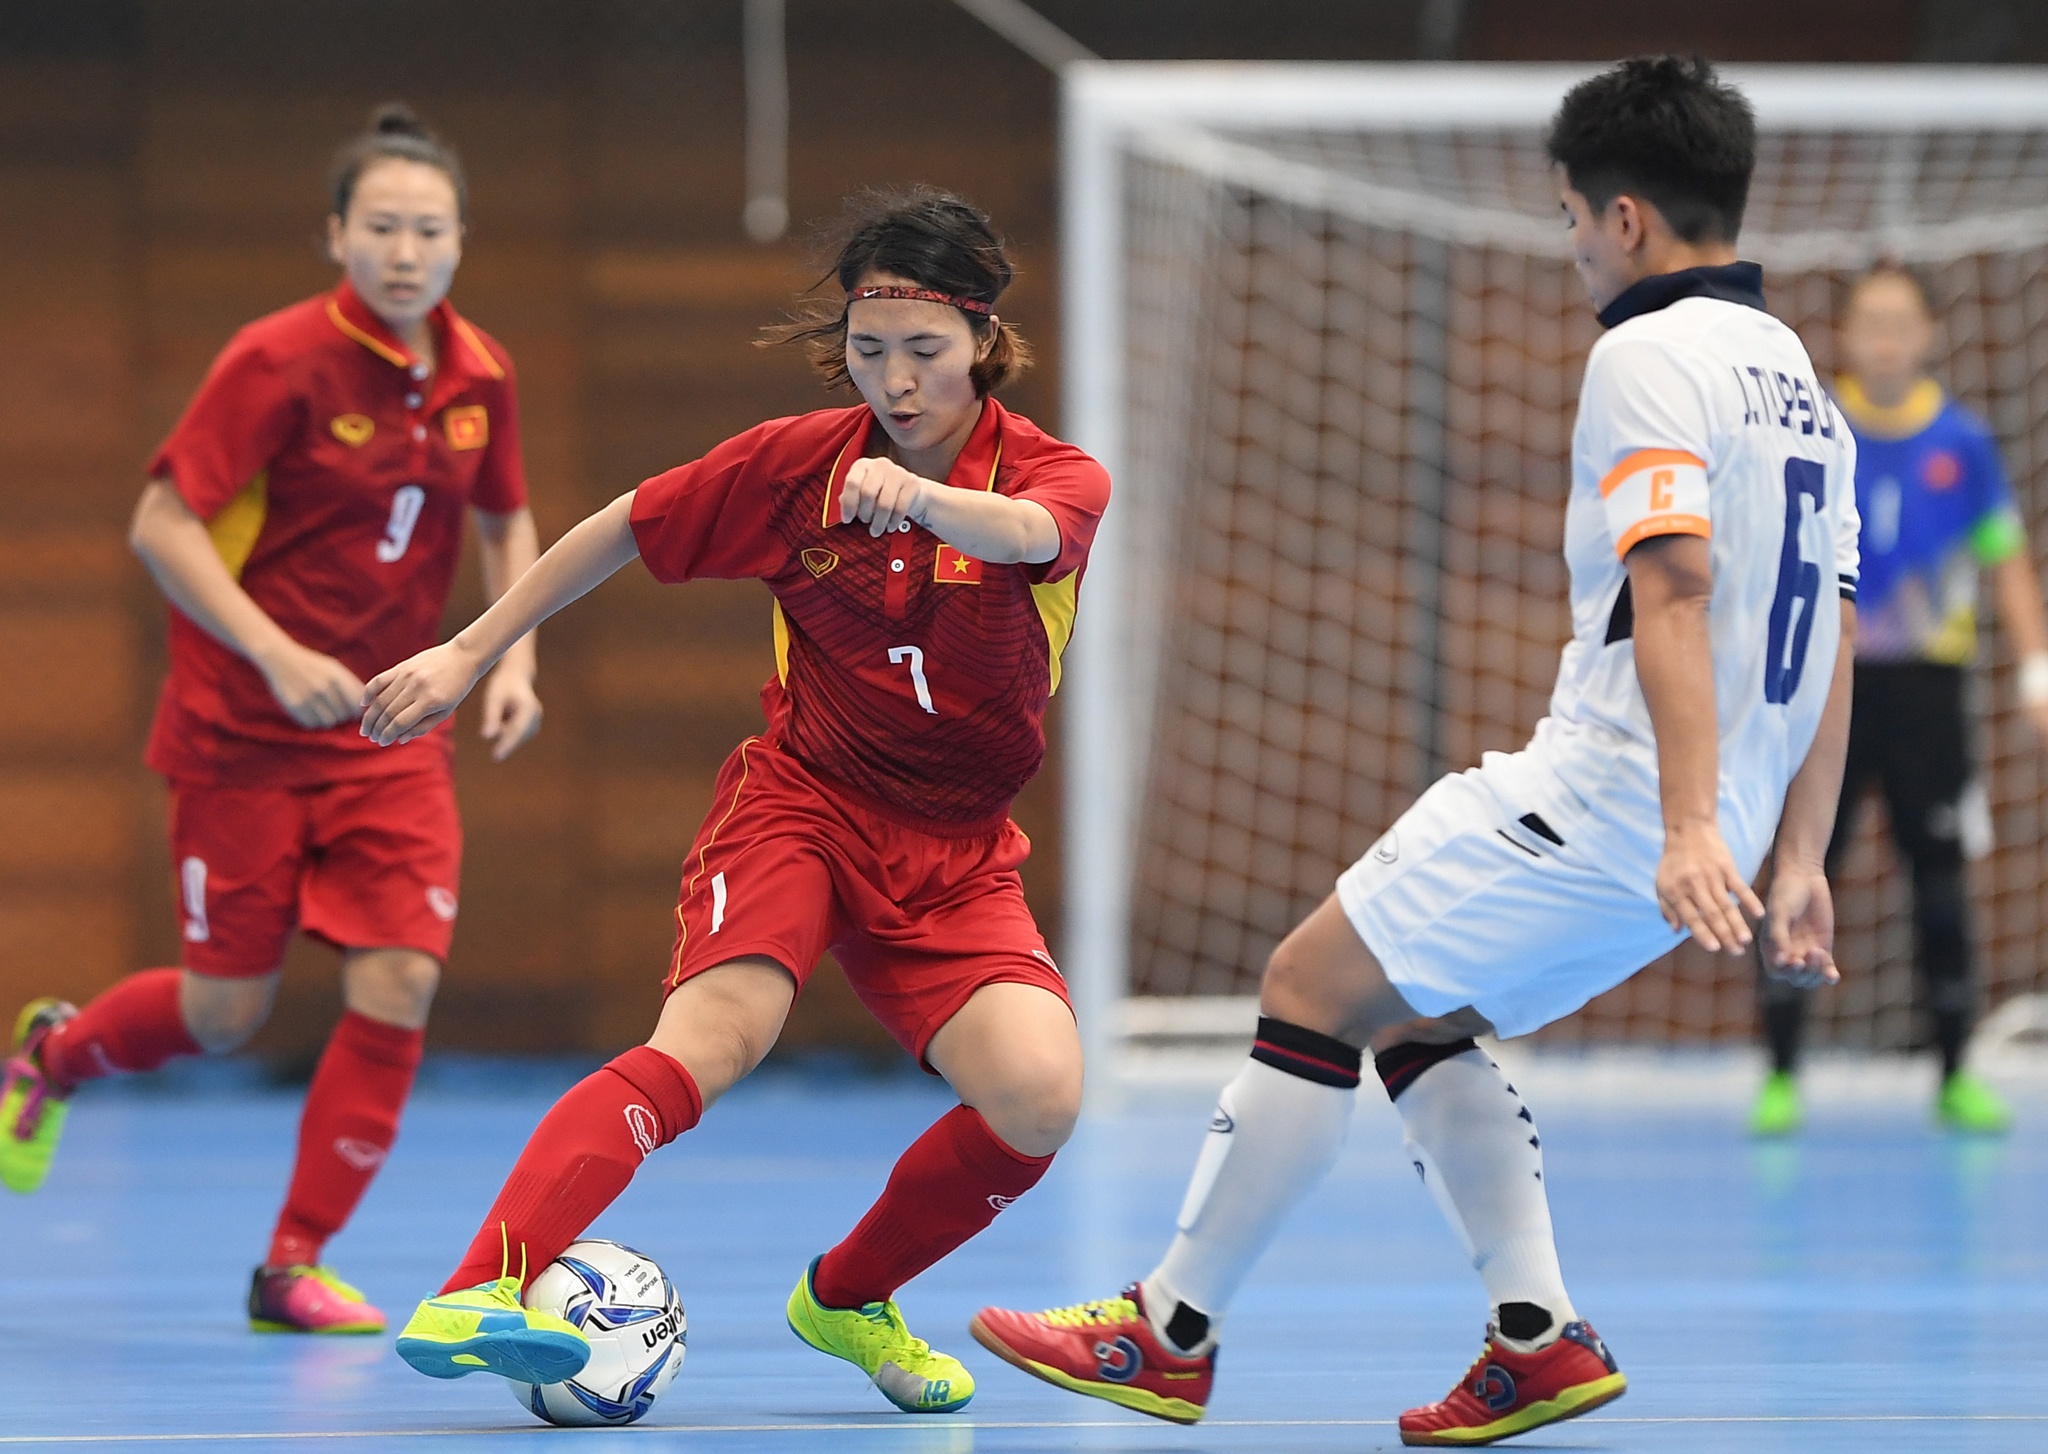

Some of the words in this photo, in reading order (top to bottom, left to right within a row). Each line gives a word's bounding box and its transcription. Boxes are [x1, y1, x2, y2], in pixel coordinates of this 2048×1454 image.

[375, 485, 426, 564] 9
[1650, 469, 1675, 511] C
[1765, 456, 1826, 705] 6
[887, 645, 939, 715] 7
